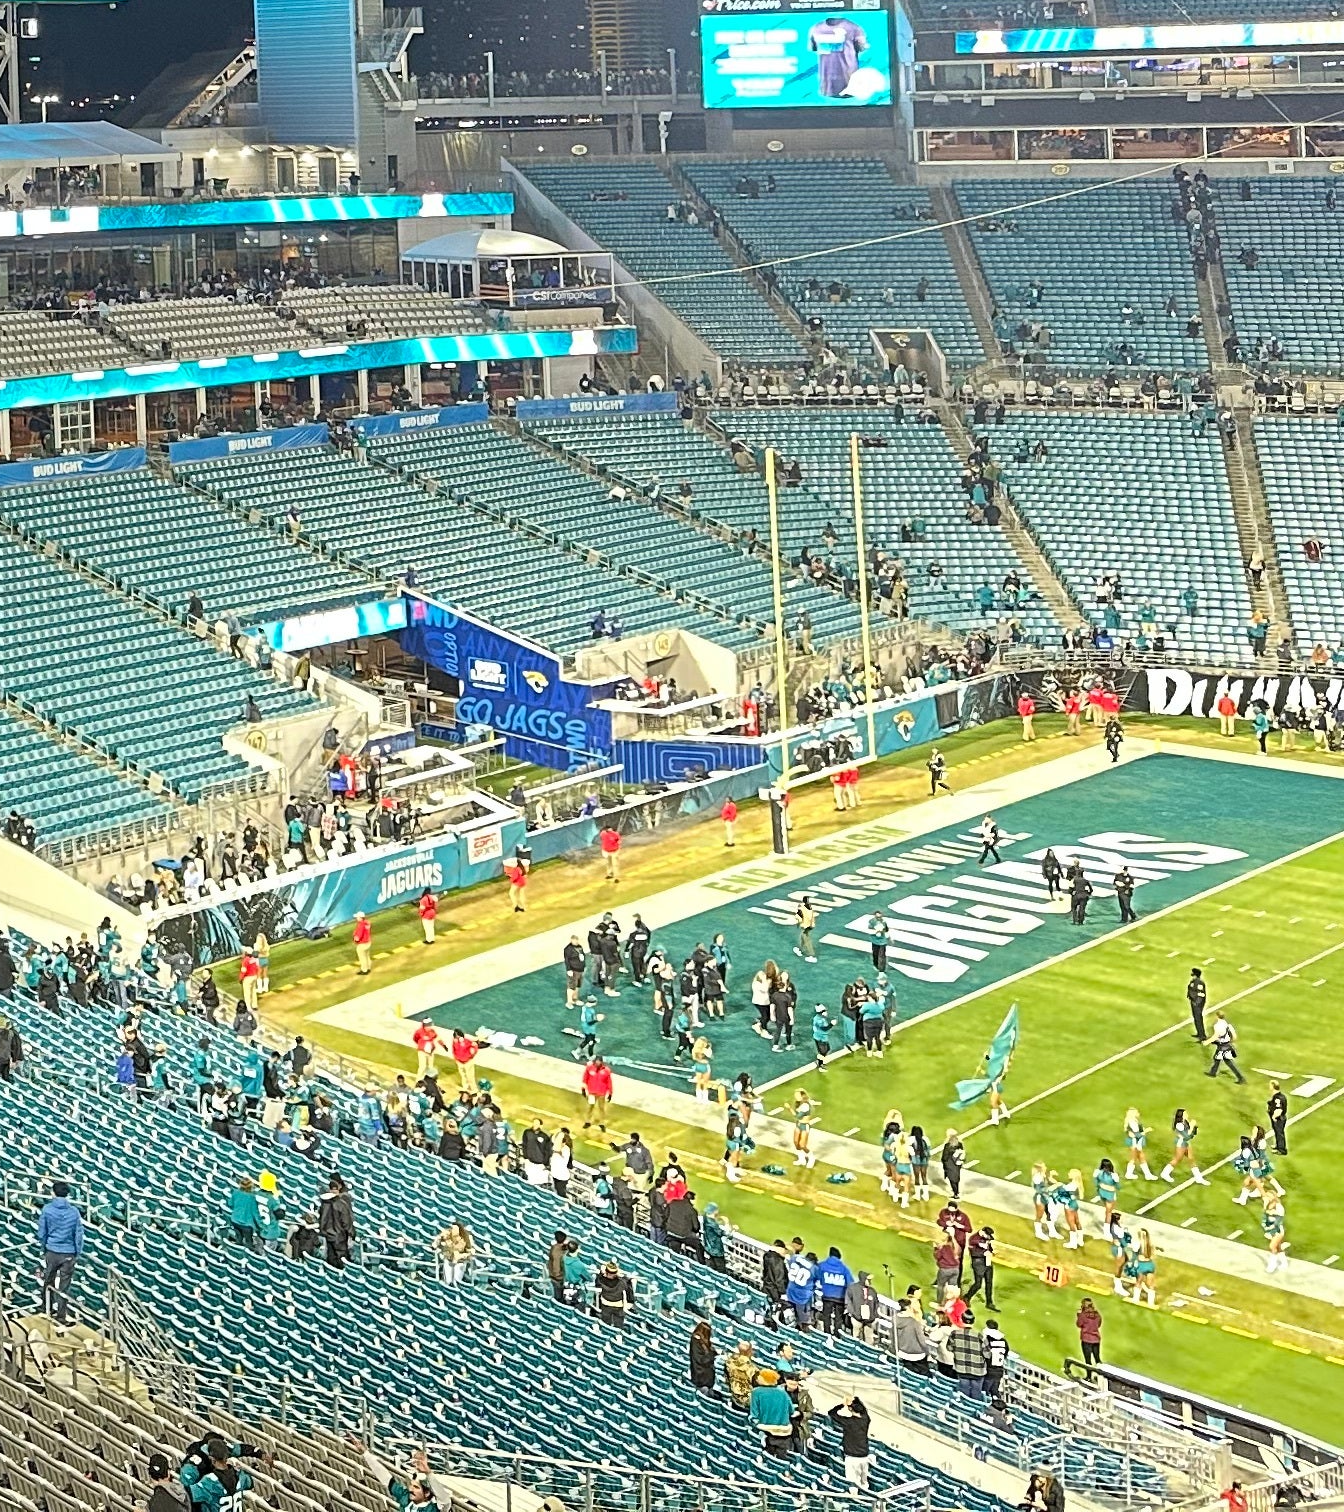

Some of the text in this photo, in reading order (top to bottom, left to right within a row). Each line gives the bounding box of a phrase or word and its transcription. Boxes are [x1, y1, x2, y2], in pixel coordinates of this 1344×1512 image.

[570, 400, 625, 412] BUD LIGHT
[400, 413, 440, 428] BUD LIGHT
[228, 436, 272, 451] BUD LIGHT
[33, 461, 84, 477] BUD LIGHT
[456, 697, 493, 725] GO
[495, 704, 567, 740] JAGS
[384, 850, 434, 872] JACKSONVILLE
[377, 862, 443, 904] JAGUARS
[708, 866, 787, 895] END
[788, 1263, 811, 1286] 20
[1047, 1266, 1058, 1281] 10
